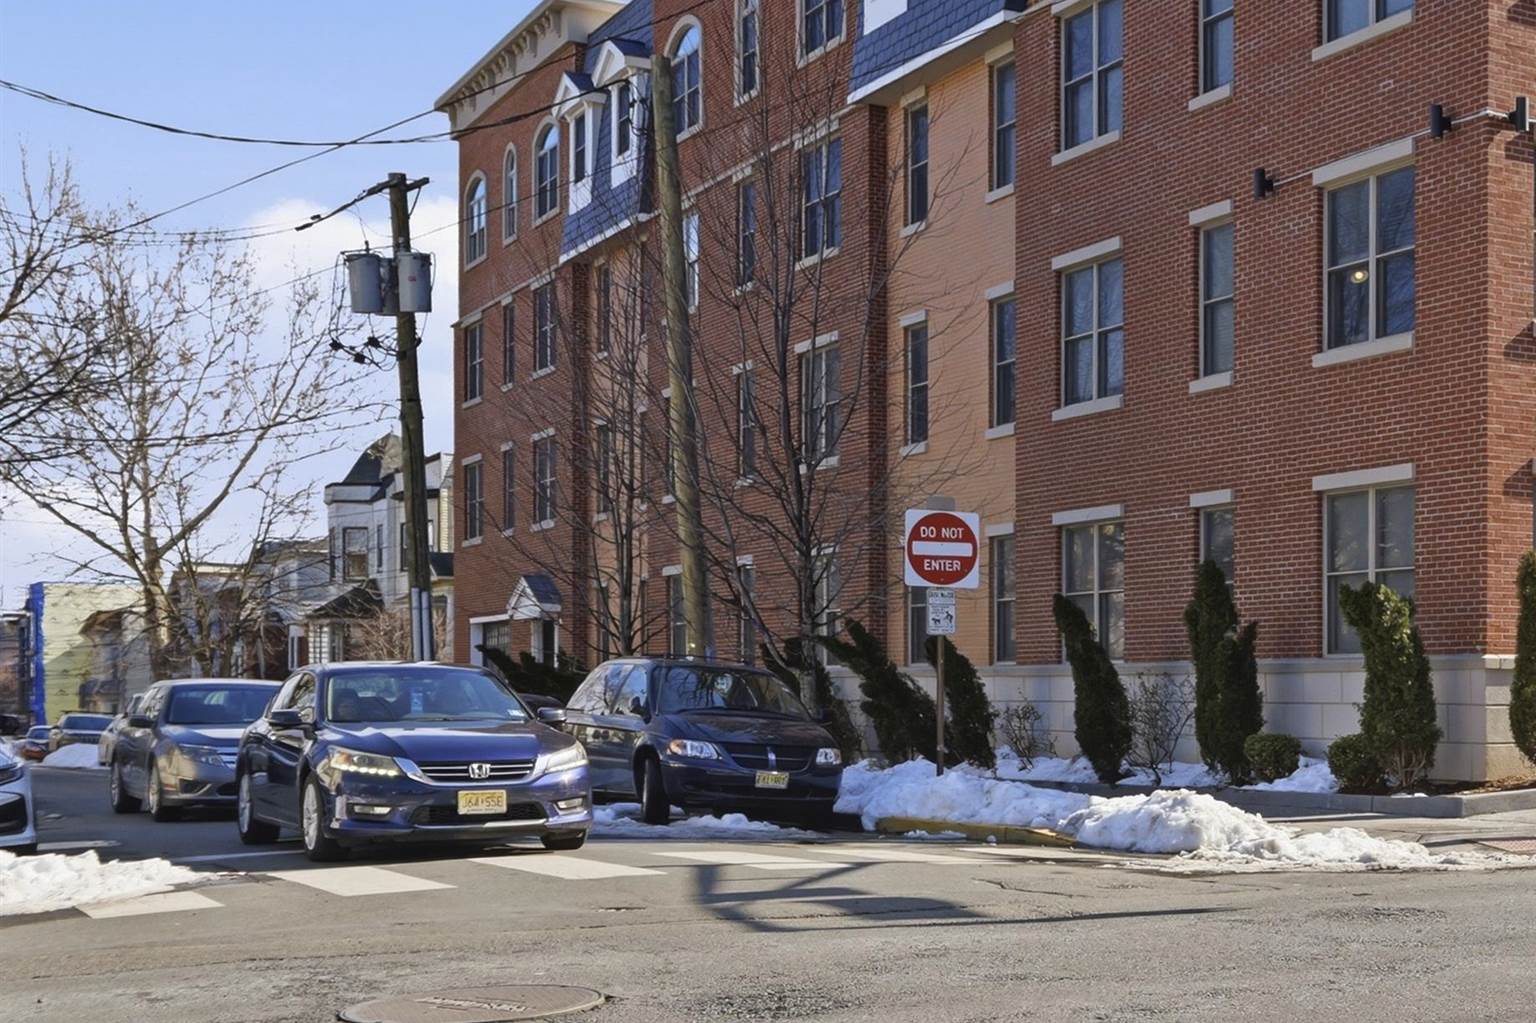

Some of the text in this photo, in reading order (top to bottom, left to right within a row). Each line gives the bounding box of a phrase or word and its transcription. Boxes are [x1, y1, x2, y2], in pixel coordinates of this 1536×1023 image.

[920, 526, 965, 539] DO NOT
[923, 559, 961, 572] ENTER
